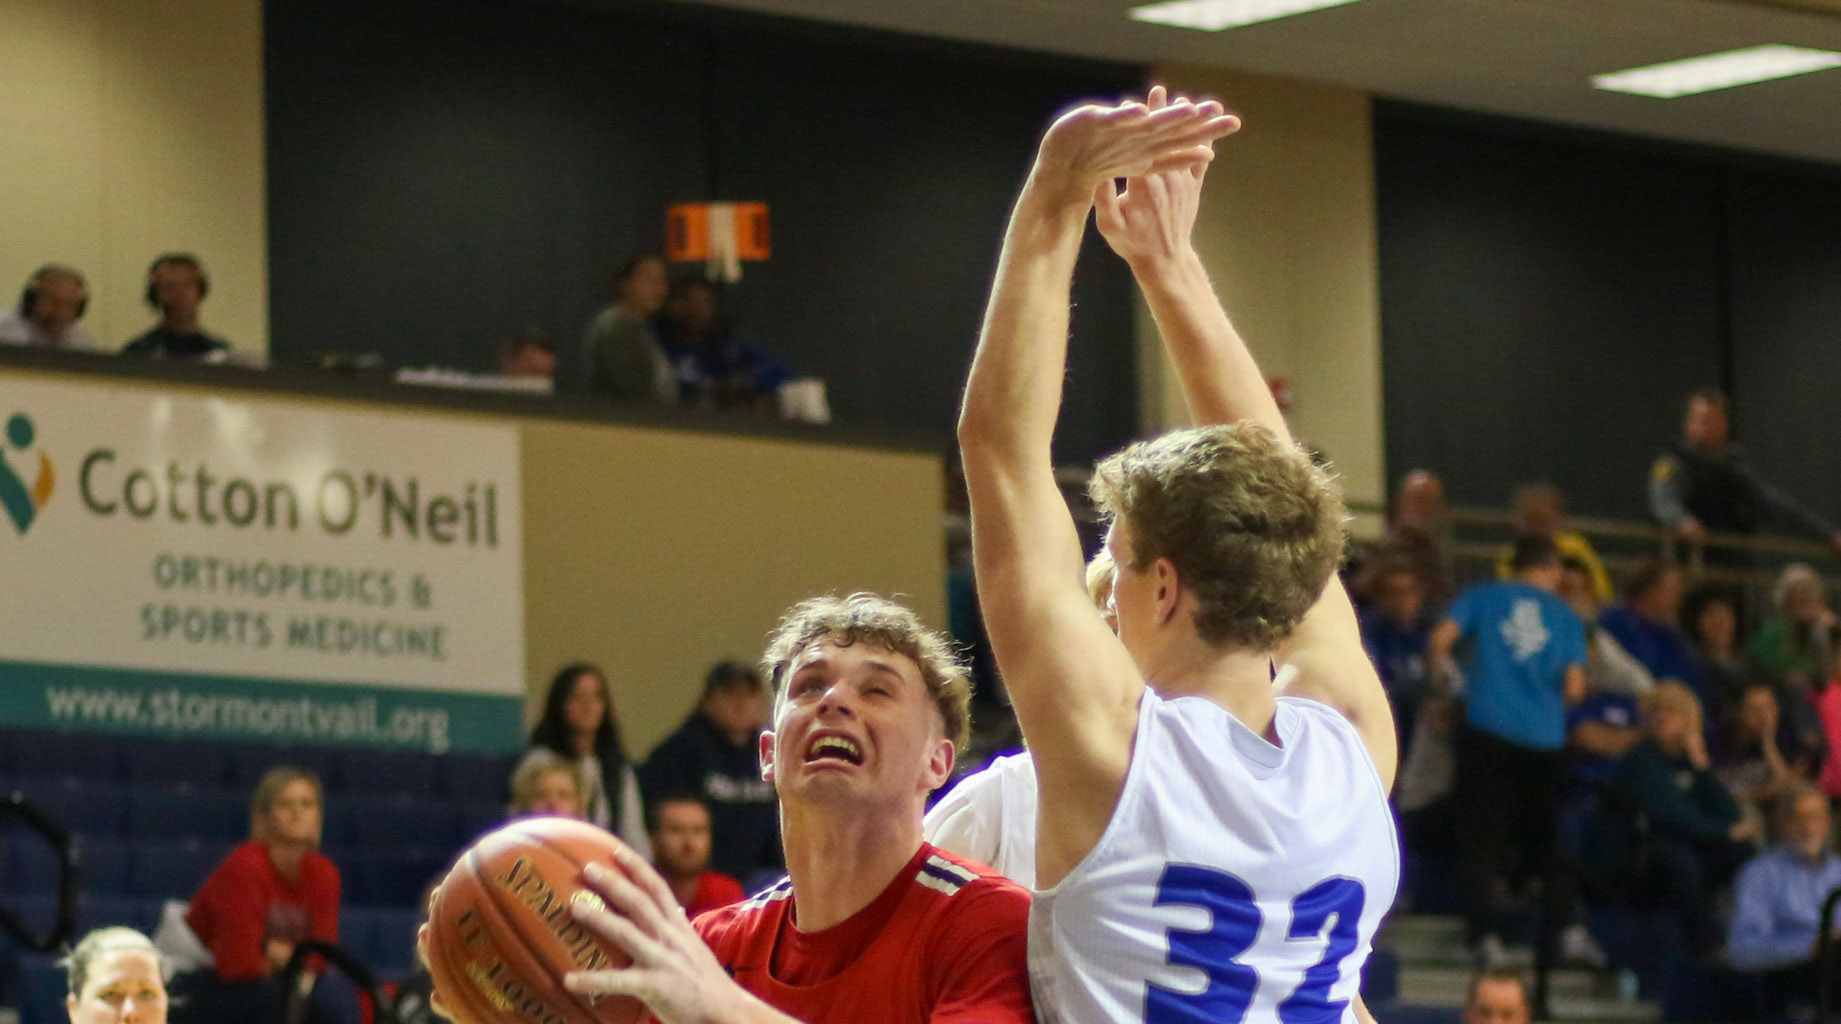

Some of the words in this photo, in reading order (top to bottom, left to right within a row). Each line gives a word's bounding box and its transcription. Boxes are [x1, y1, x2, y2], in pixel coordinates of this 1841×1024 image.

[79, 447, 300, 532] Cotton
[316, 469, 501, 547] O'Neil
[153, 553, 396, 606] ORTHOPEDICS
[411, 577, 432, 609] &
[140, 605, 271, 650] SPORTS
[286, 624, 447, 661] MEDICINE
[46, 686, 451, 754] www.stormontvail.org
